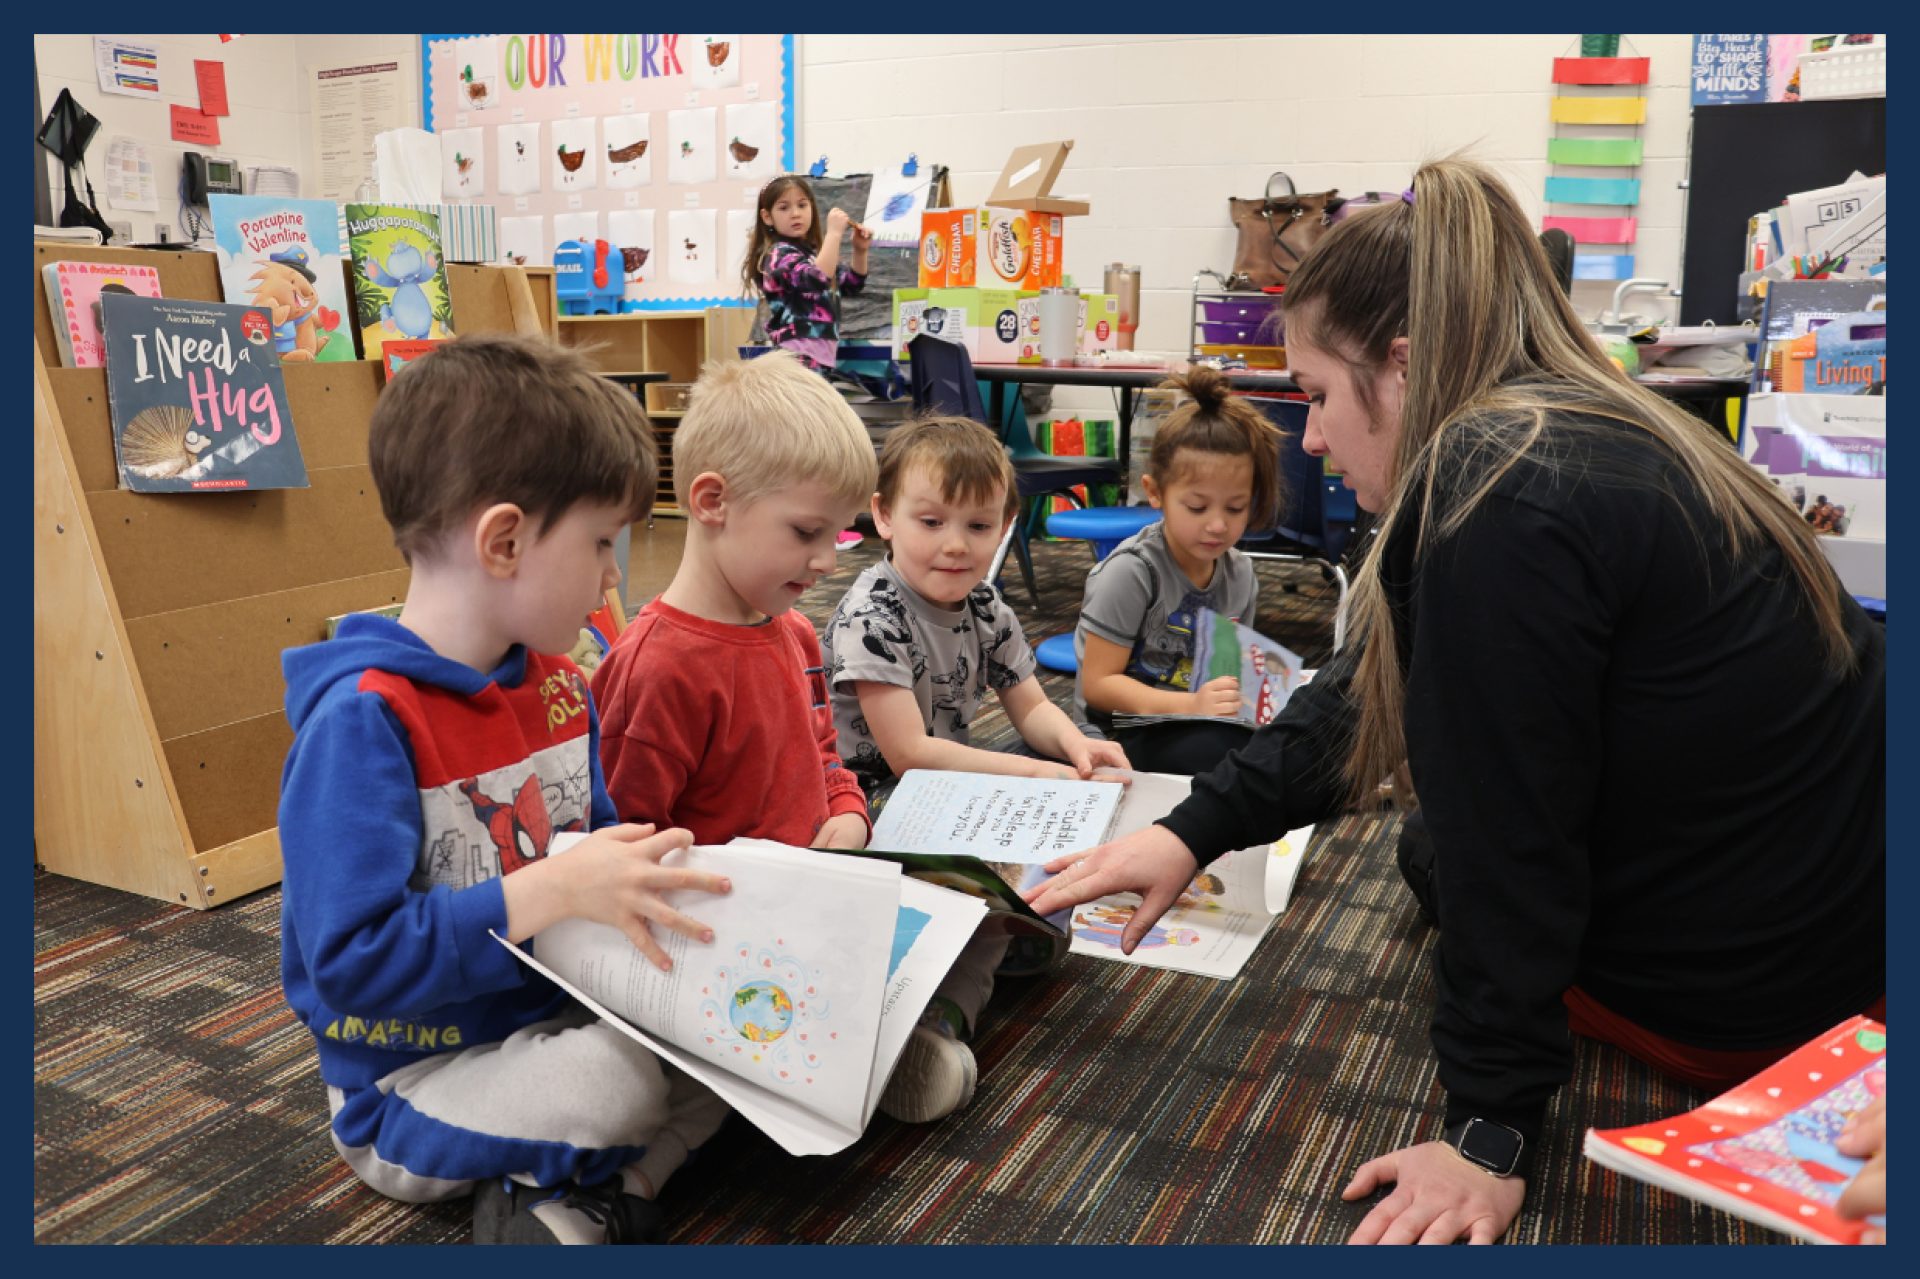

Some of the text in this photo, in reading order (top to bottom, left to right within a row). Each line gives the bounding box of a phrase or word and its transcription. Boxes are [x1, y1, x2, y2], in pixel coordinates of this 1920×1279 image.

[1701, 34, 1763, 43] IT TAKES A
[505, 34, 684, 91] OUR WORK
[1696, 52, 1763, 63] TO SHAPE
[1696, 77, 1761, 92] MINDS
[1825, 202, 1854, 217] 4 5
[239, 211, 304, 239] Porcupine
[248, 227, 307, 254] Valentine
[950, 221, 962, 275] CHEDDAR
[997, 220, 1018, 275] Goldfish
[1031, 226, 1043, 277] CHEDDAR
[556, 264, 583, 274] MAIL
[1000, 314, 1016, 330] 28
[131, 333, 155, 384] I
[155, 326, 238, 384] Need
[238, 347, 251, 364] a
[1815, 359, 1873, 389] Living
[187, 366, 282, 446] Hug
[1861, 444, 1871, 452] of
[948, 813, 972, 841] you.
[993, 810, 1027, 847] asleep
[1052, 810, 1079, 849] cuddle
